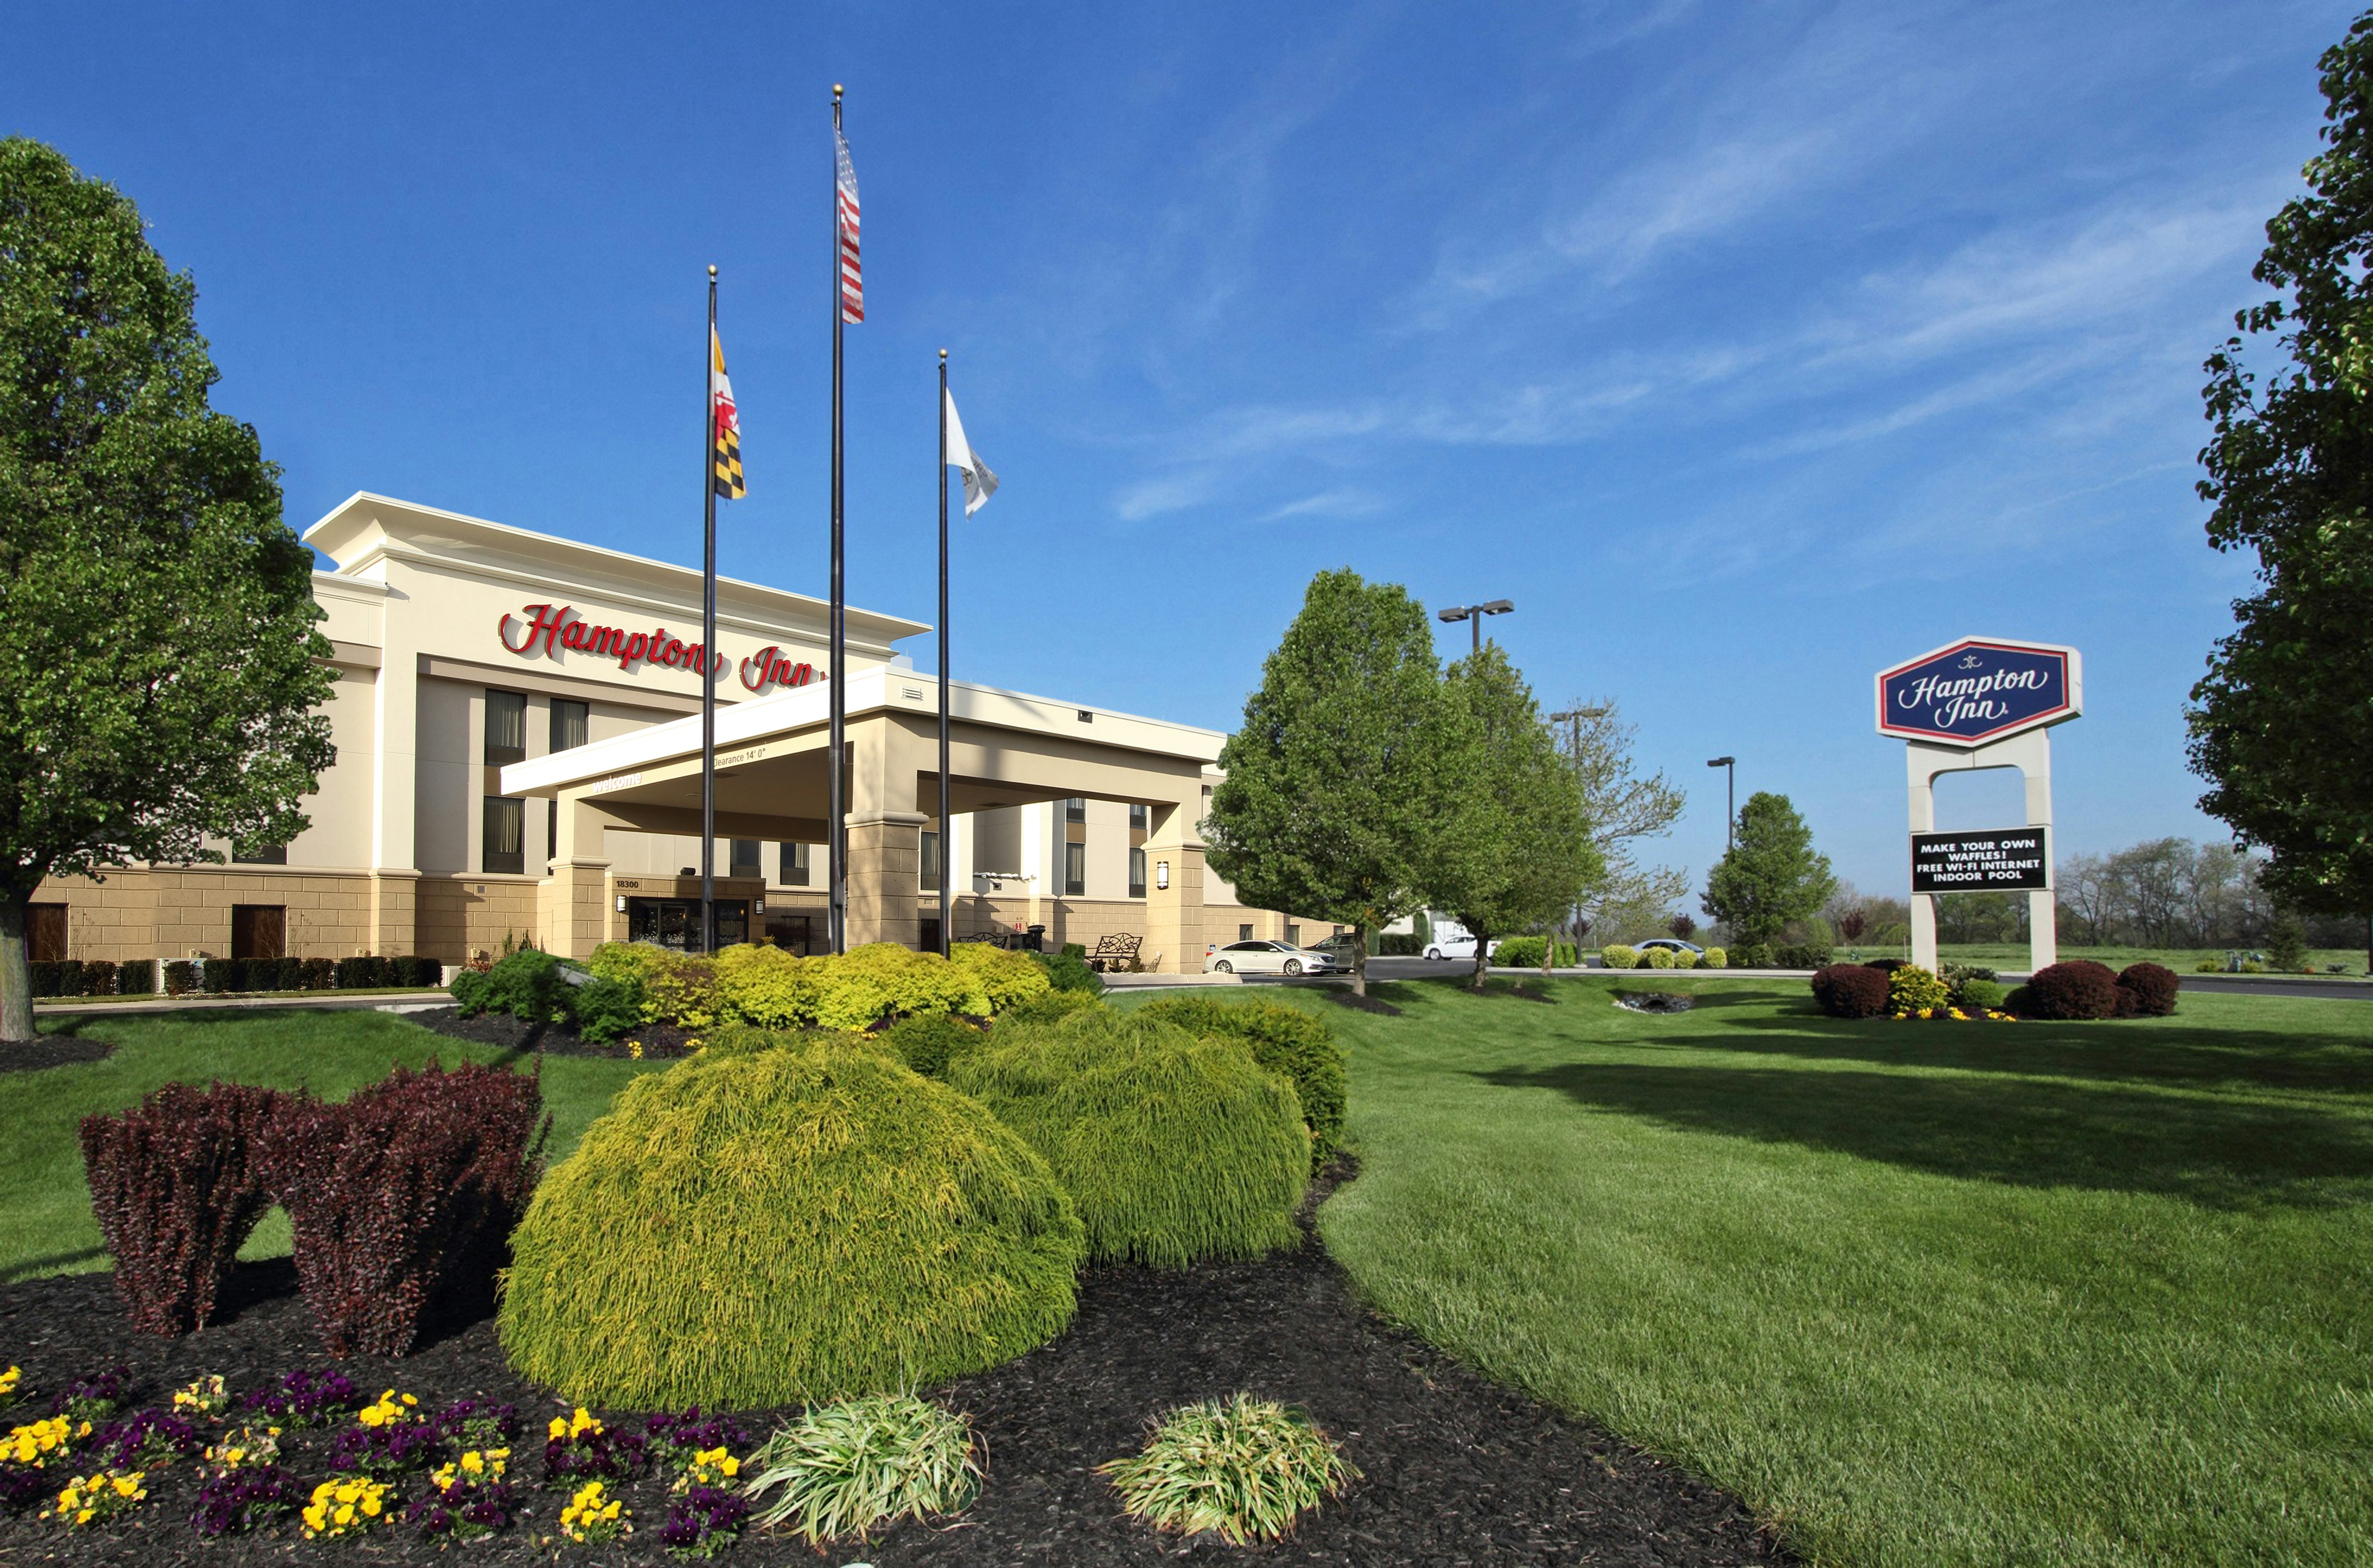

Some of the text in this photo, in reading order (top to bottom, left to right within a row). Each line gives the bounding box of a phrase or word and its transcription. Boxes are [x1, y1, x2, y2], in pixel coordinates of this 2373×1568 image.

[498, 604, 826, 691] Hampton Inn
[1898, 669, 2048, 708] Hampton
[1934, 696, 2007, 728] Inn
[592, 772, 642, 793] welcome
[1921, 839, 2035, 853] MAKE YOUR OWN
[1948, 851, 2006, 862] WAFFLES!
[1917, 860, 2041, 873] FREE WI-FI INTERNET
[1933, 870, 2022, 881] INDOOR POOL
